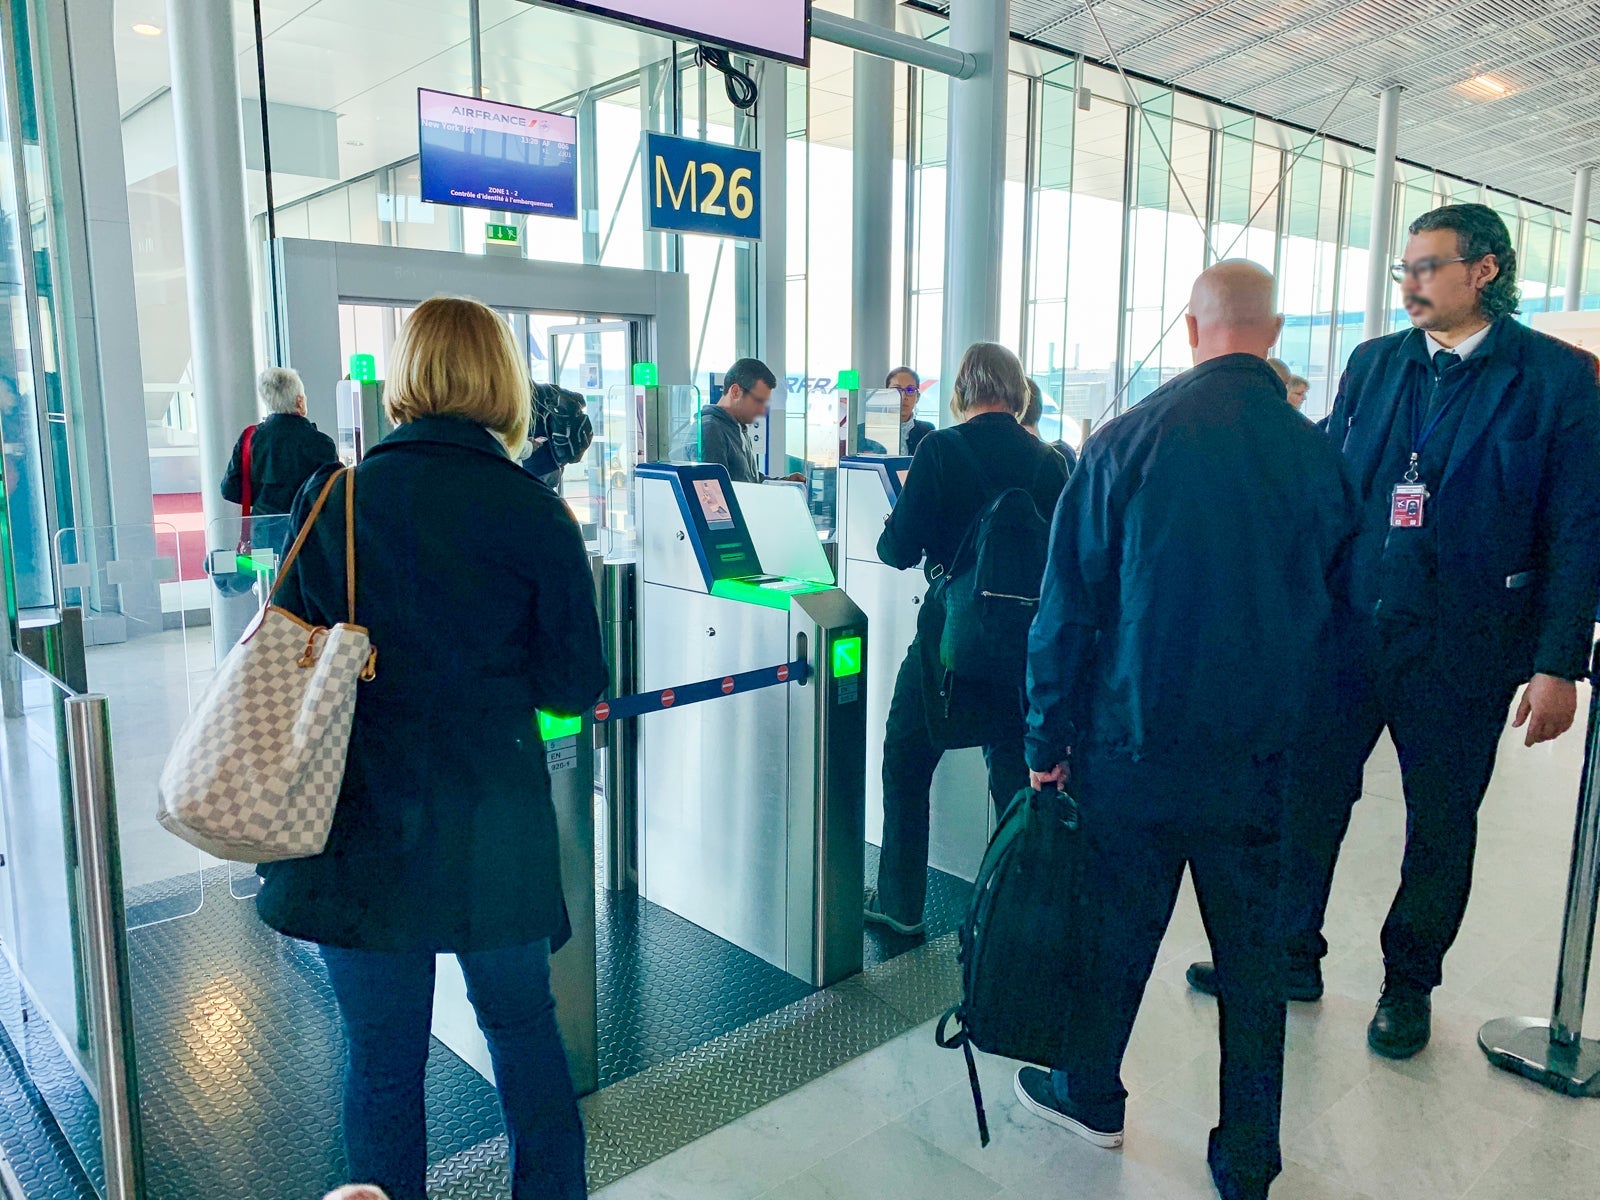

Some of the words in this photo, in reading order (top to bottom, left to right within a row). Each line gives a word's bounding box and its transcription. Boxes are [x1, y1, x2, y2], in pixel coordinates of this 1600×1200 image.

[452, 106, 526, 126] AIRFRANCE
[422, 120, 439, 128] New
[442, 122, 460, 131] York
[461, 125, 476, 134] JFK
[488, 187, 505, 195] ZONE
[655, 154, 754, 219] M26
[450, 189, 475, 198] Contrôle
[509, 197, 554, 208] l'embarquement
[551, 752, 561, 760] EN
